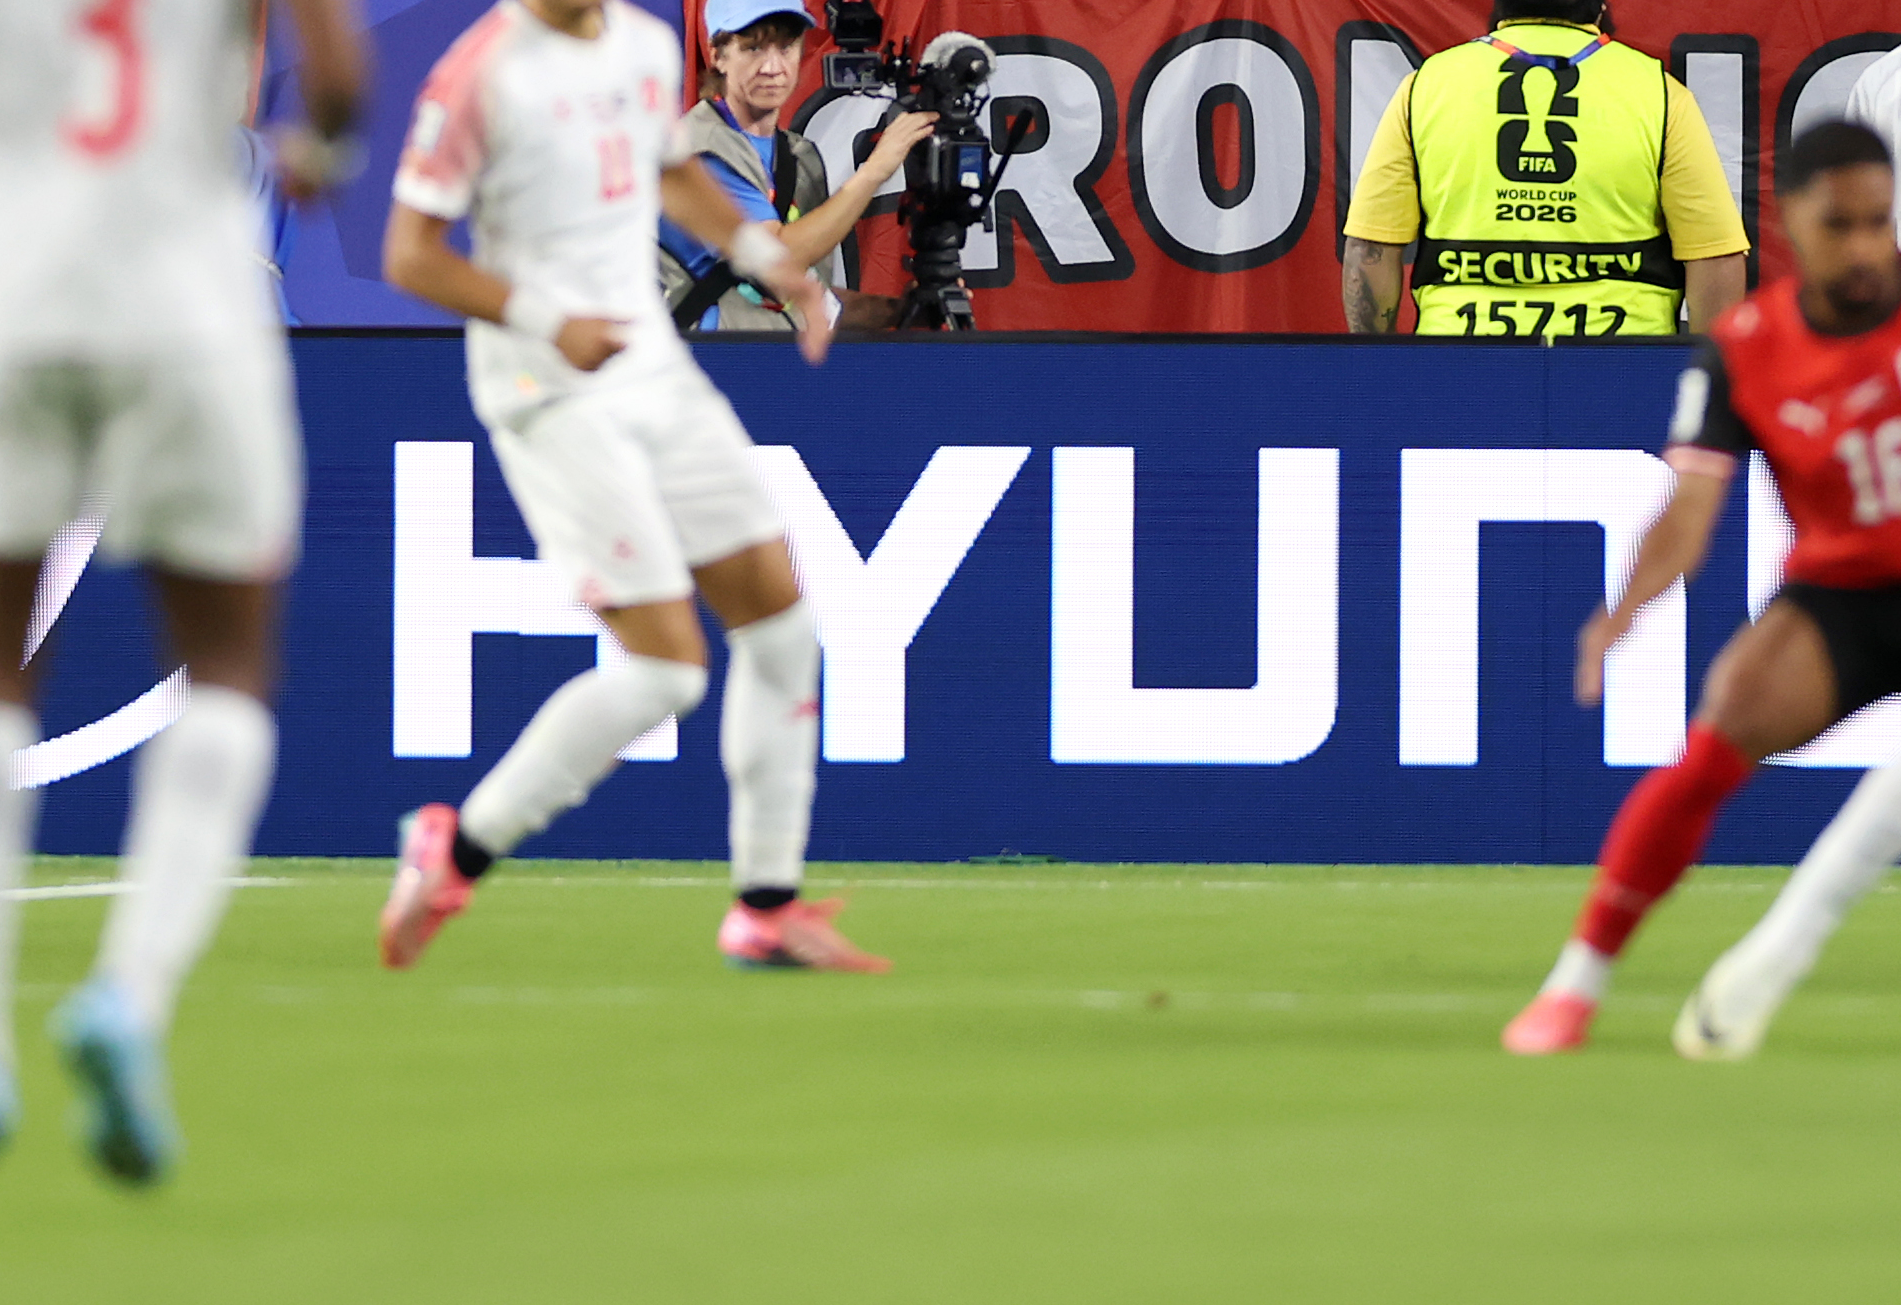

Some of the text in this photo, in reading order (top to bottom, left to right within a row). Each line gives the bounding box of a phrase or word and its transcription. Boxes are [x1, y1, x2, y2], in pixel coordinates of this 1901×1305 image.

[1517, 155, 1556, 173] FIFA
[1496, 188, 1577, 202] WORLD CUP
[1495, 203, 1578, 223] 2026
[1437, 248, 1643, 285] SECURITY
[1453, 300, 1628, 338] 15712
